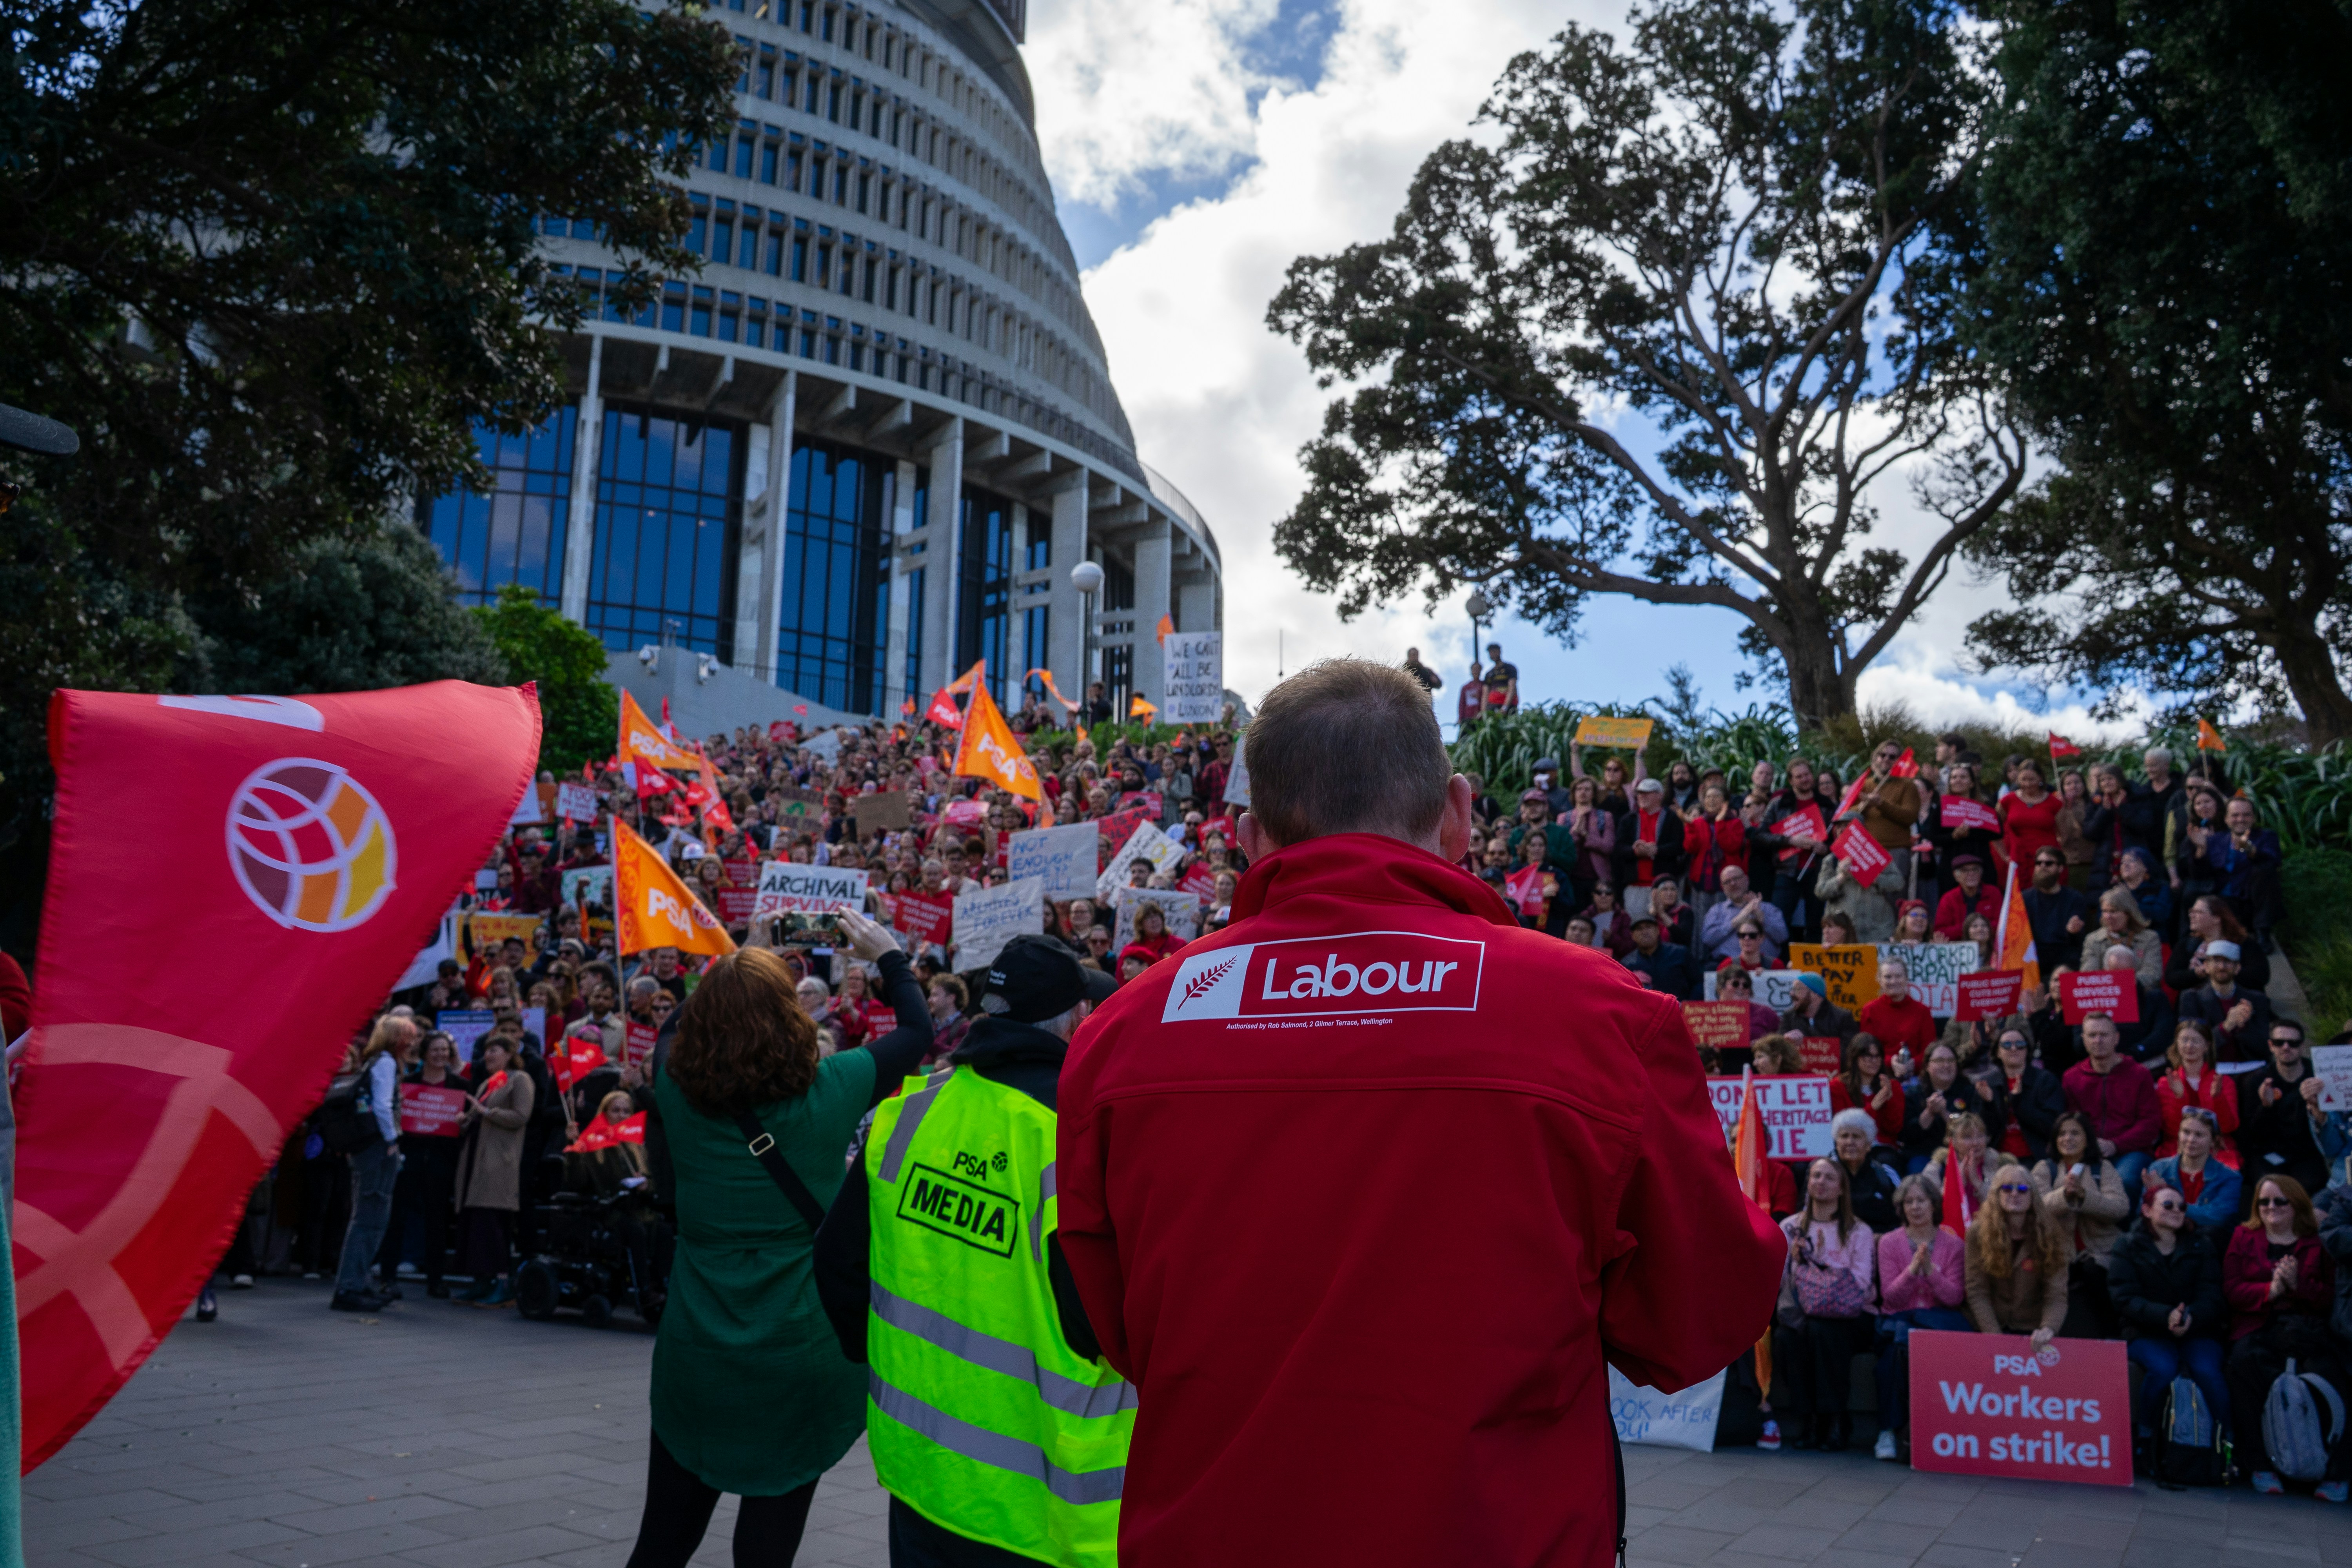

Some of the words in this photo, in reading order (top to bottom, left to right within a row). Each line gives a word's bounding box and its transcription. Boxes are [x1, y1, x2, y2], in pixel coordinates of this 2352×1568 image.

[1170, 638, 1190, 659] WE
[1172, 662, 1192, 680] ALL
[1197, 662, 1212, 678] BE
[630, 730, 665, 760] PSA
[977, 732, 1016, 782] PSA
[1013, 836, 1048, 855] NOT
[1013, 853, 1073, 871] ENOUGH
[763, 875, 862, 899] ARCHIVAL
[648, 887, 694, 940] PSA
[973, 906, 1034, 931] FOREVER
[1803, 951, 1865, 966] BETTER
[1262, 954, 1458, 1000] Labour
[1821, 968, 1855, 982] PAY
[1960, 979, 1989, 989] PUBLIC
[1990, 975, 2021, 988] SERVICE
[2077, 974, 2114, 986] PUBLIC
[1969, 989, 1991, 999] CUTS
[1993, 985, 2013, 996] HURT
[2072, 985, 2122, 998] SERVICES
[1970, 995, 2010, 1008] EVERYONE
[2077, 997, 2118, 1009] MATTER
[1704, 1014, 1717, 1023] the
[1719, 1016, 1737, 1025] only
[1708, 1033, 1741, 1046] support
[1807, 1040, 1831, 1054] help
[1781, 1083, 1827, 1105] LET
[1762, 1109, 1830, 1126] HERITAGE
[953, 1151, 987, 1181] PSA
[910, 1178, 1004, 1243] MEDIA
[1994, 1354, 2042, 1376] PSA
[1611, 1397, 1652, 1421] OOK
[1659, 1404, 1713, 1423] AFTER
[1939, 1380, 2101, 1423] Workers
[1932, 1432, 1979, 1459] on
[1989, 1430, 2112, 1468] strike!
